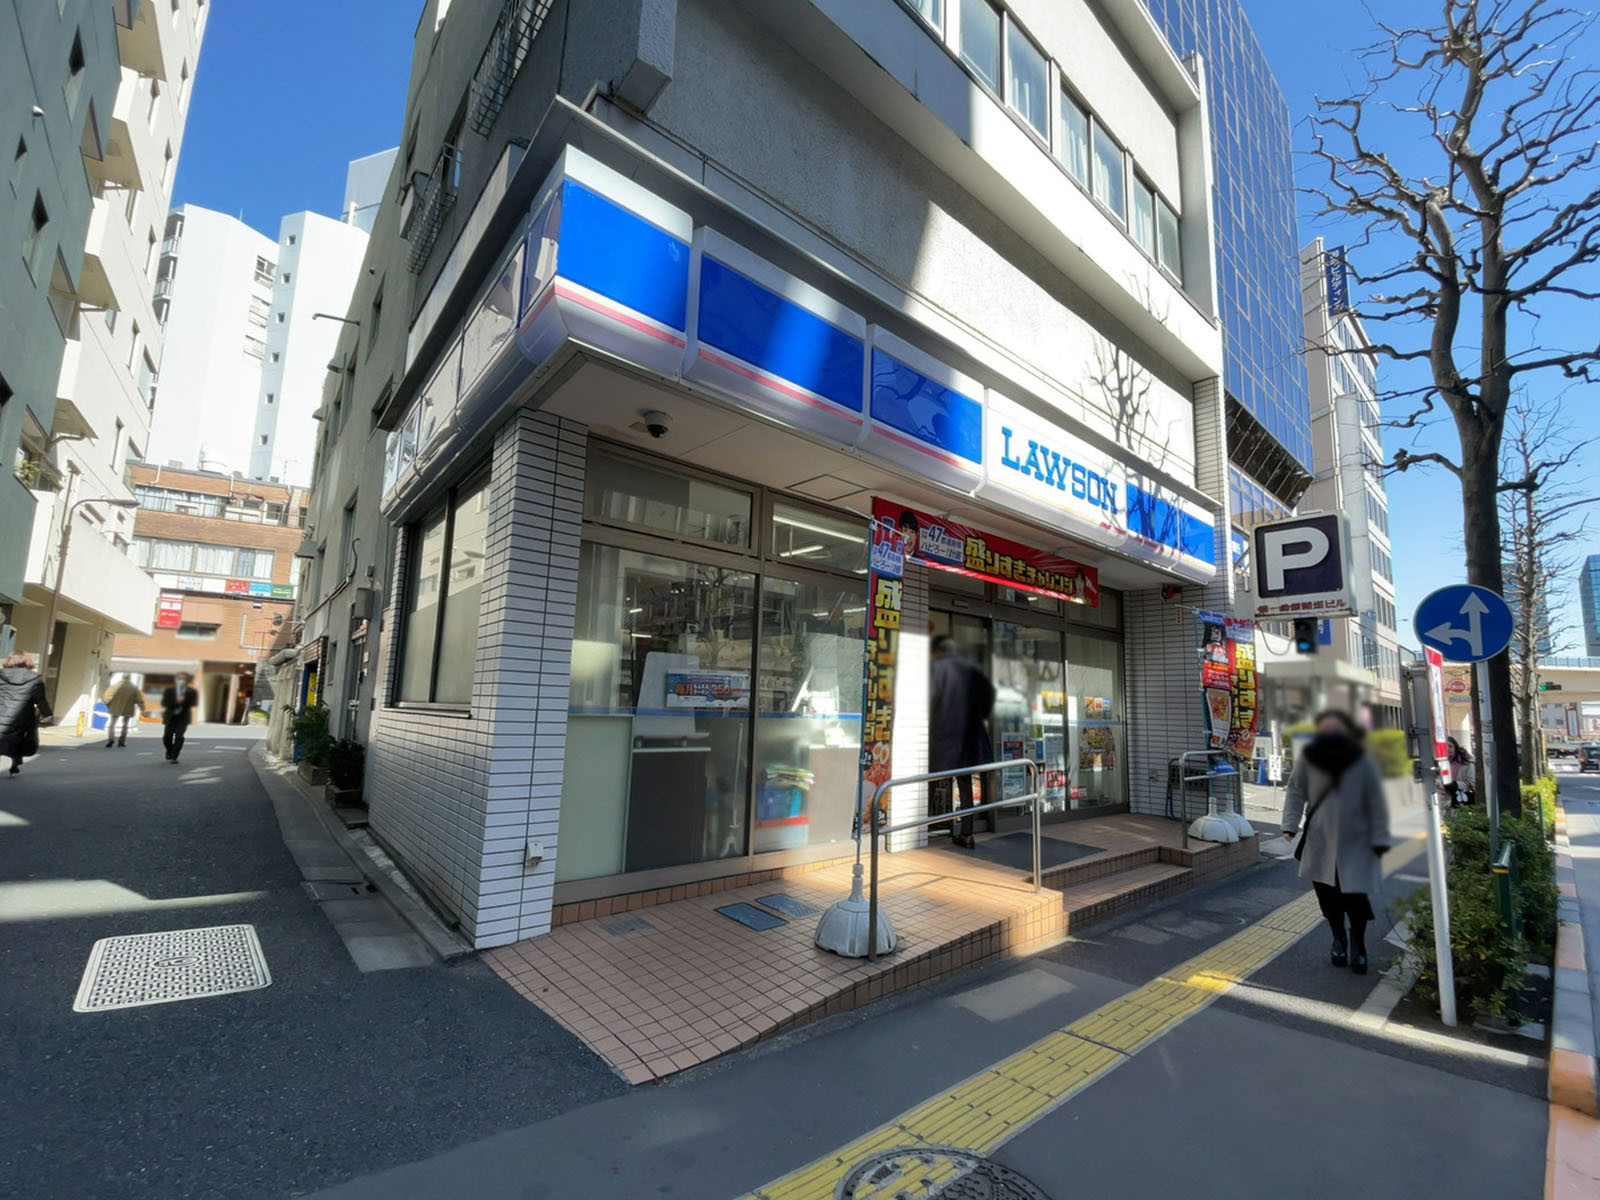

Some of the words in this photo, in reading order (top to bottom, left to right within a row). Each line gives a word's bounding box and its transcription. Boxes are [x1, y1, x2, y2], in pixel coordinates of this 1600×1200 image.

[1001, 426, 1118, 514] LAWSON
[965, 535, 1074, 595] 盛りすぎチャレンジ
[1263, 526, 1330, 591] P
[874, 578, 903, 741] 盛りすぎ
